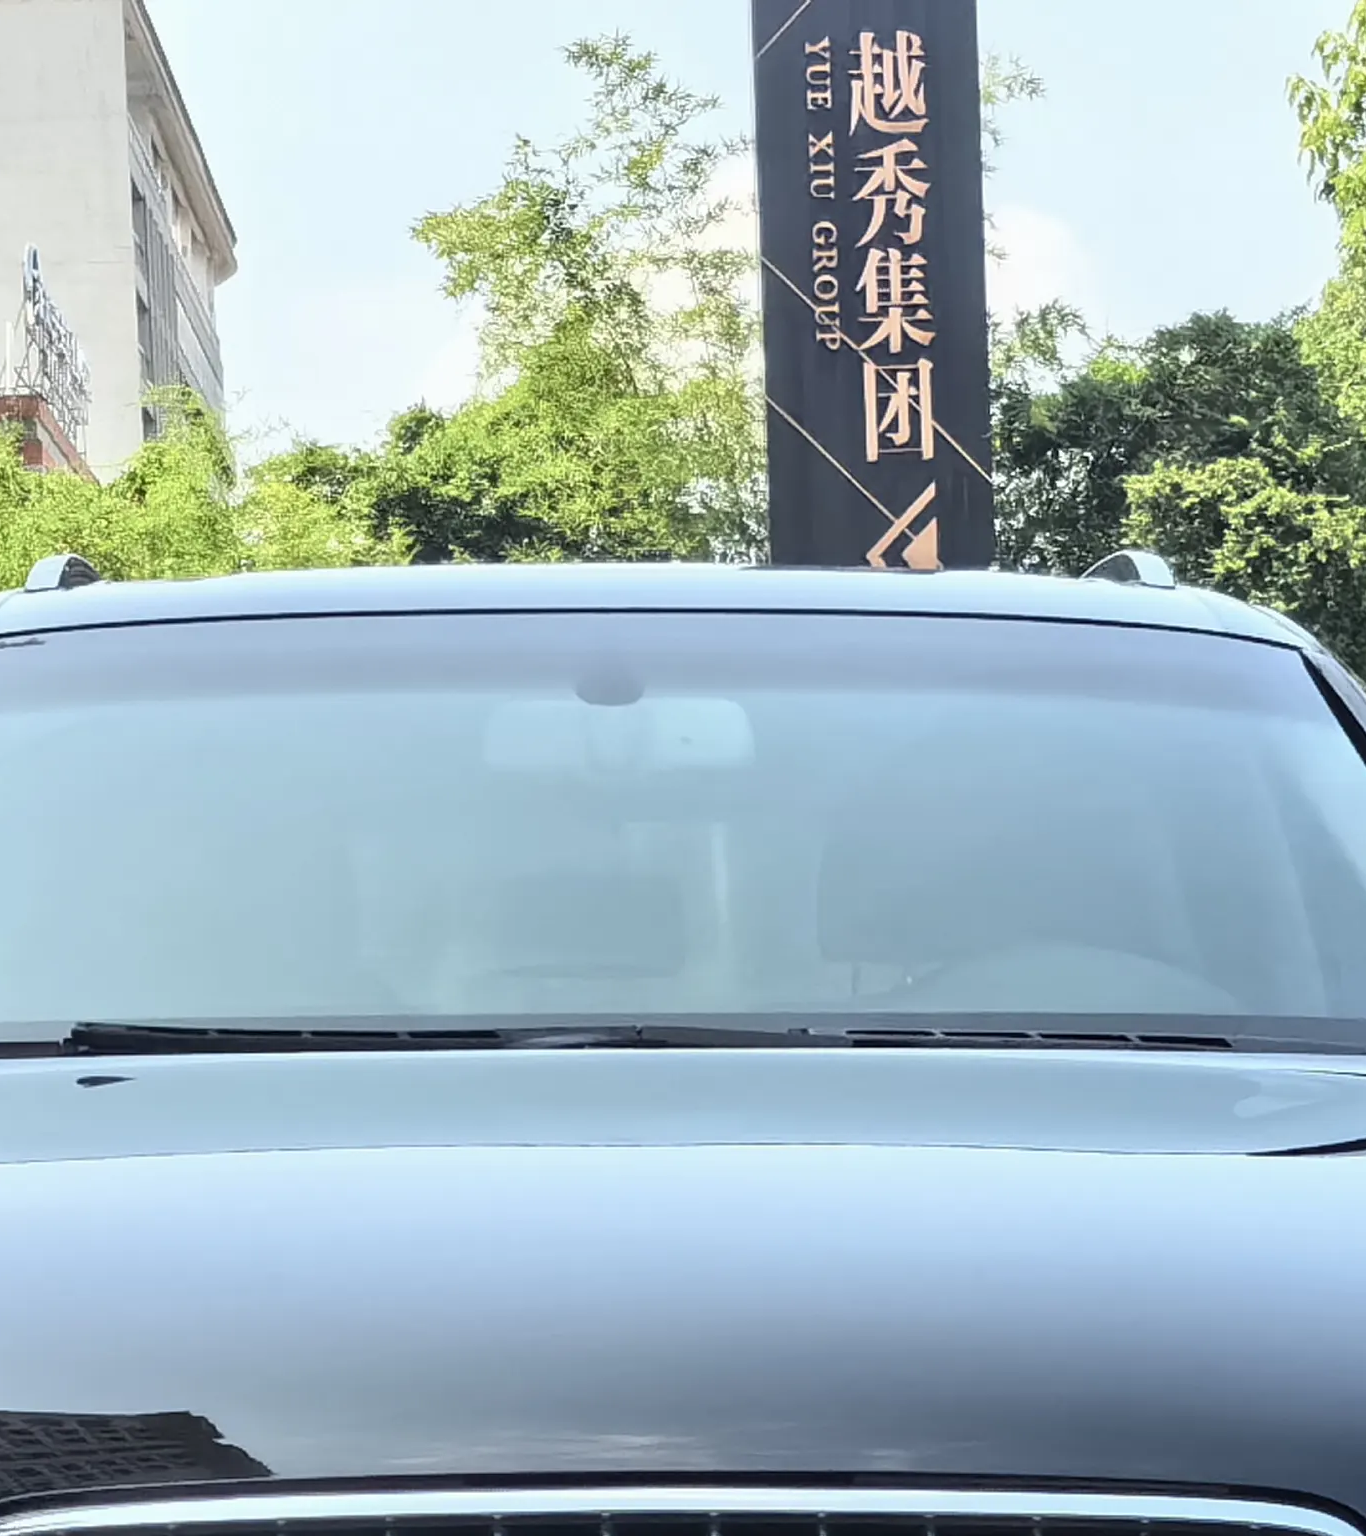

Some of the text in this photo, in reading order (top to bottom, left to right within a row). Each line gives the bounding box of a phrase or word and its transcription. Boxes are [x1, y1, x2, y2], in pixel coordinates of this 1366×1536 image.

[803, 36, 841, 352] YUE XIU GROUP
[848, 29, 936, 463] 越秀集团
